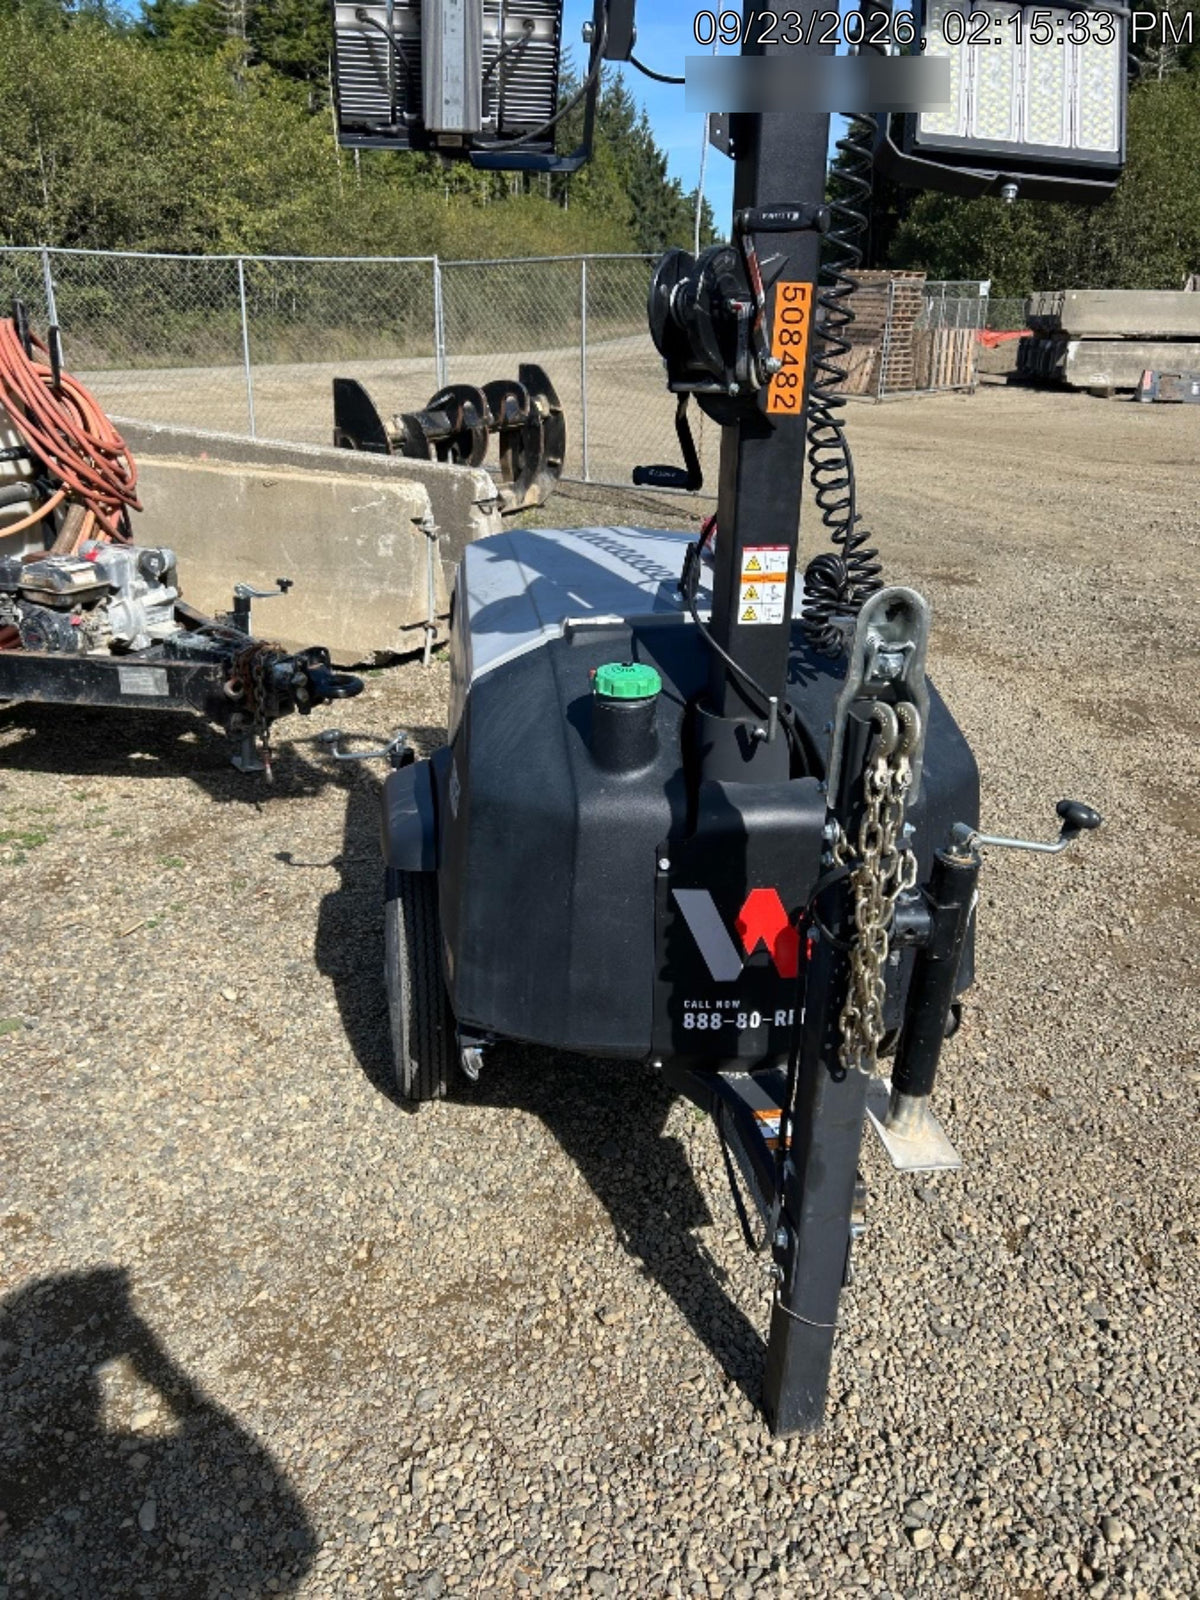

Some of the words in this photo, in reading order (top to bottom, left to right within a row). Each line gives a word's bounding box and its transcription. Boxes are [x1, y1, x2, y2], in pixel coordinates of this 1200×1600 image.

[772, 285, 806, 410] 508482
[683, 1000, 712, 1009] CALL
[715, 1000, 741, 1009] NOW
[683, 1008, 806, 1030] 888-80-R
